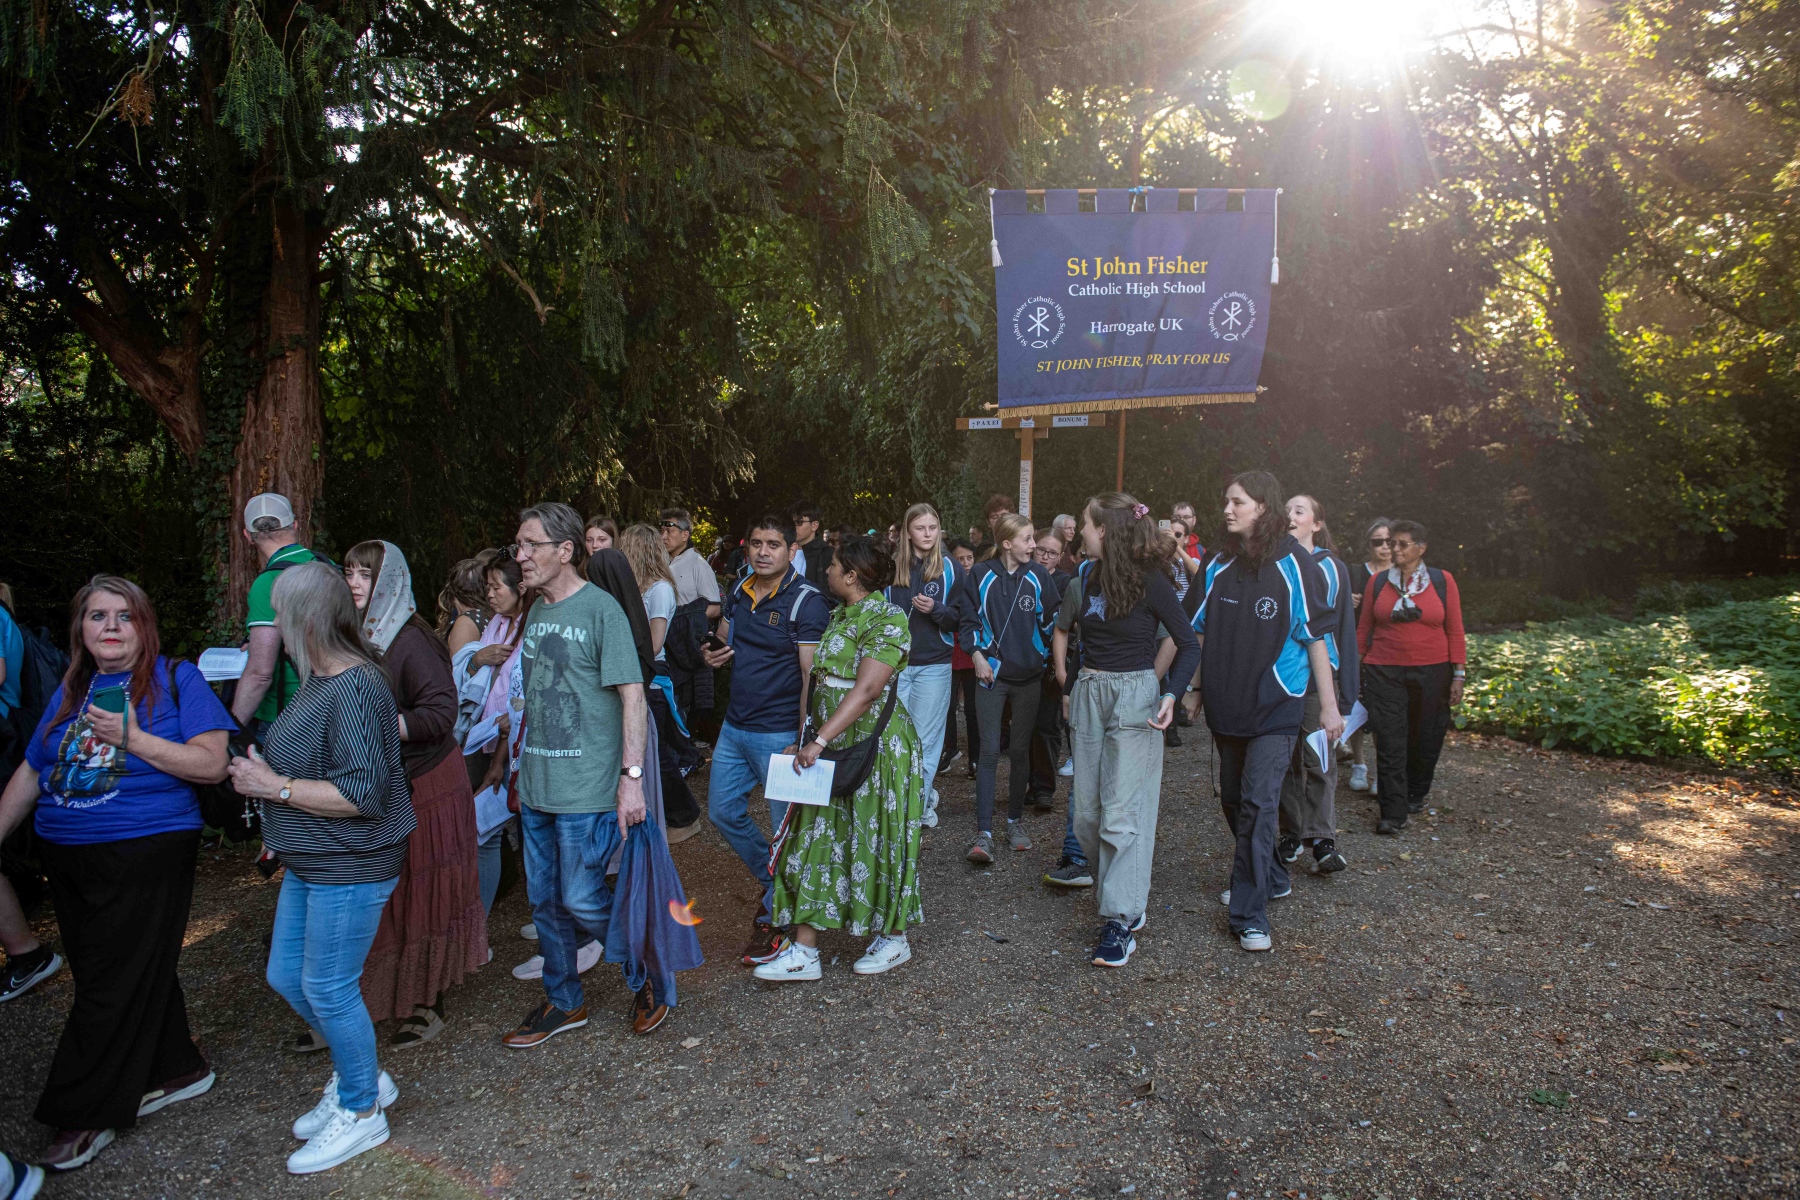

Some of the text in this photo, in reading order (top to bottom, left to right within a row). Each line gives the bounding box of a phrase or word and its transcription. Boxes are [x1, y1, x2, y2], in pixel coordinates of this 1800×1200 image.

[1067, 255, 1208, 281] St John Fisher
[1068, 281, 1206, 299] Catholic High School
[1223, 291, 1249, 301] Catholic
[1208, 296, 1223, 315] Fisher
[1247, 299, 1257, 316] High
[1012, 295, 1066, 347] St John Fisher Catholic High School
[1091, 318, 1183, 336] Harrogate, UK
[1241, 317, 1256, 339] School
[1213, 331, 1221, 339] St
[1036, 352, 1231, 374] ST JOHN FISHER, PRAY FOR US
[540, 748, 582, 758] REVISITED
